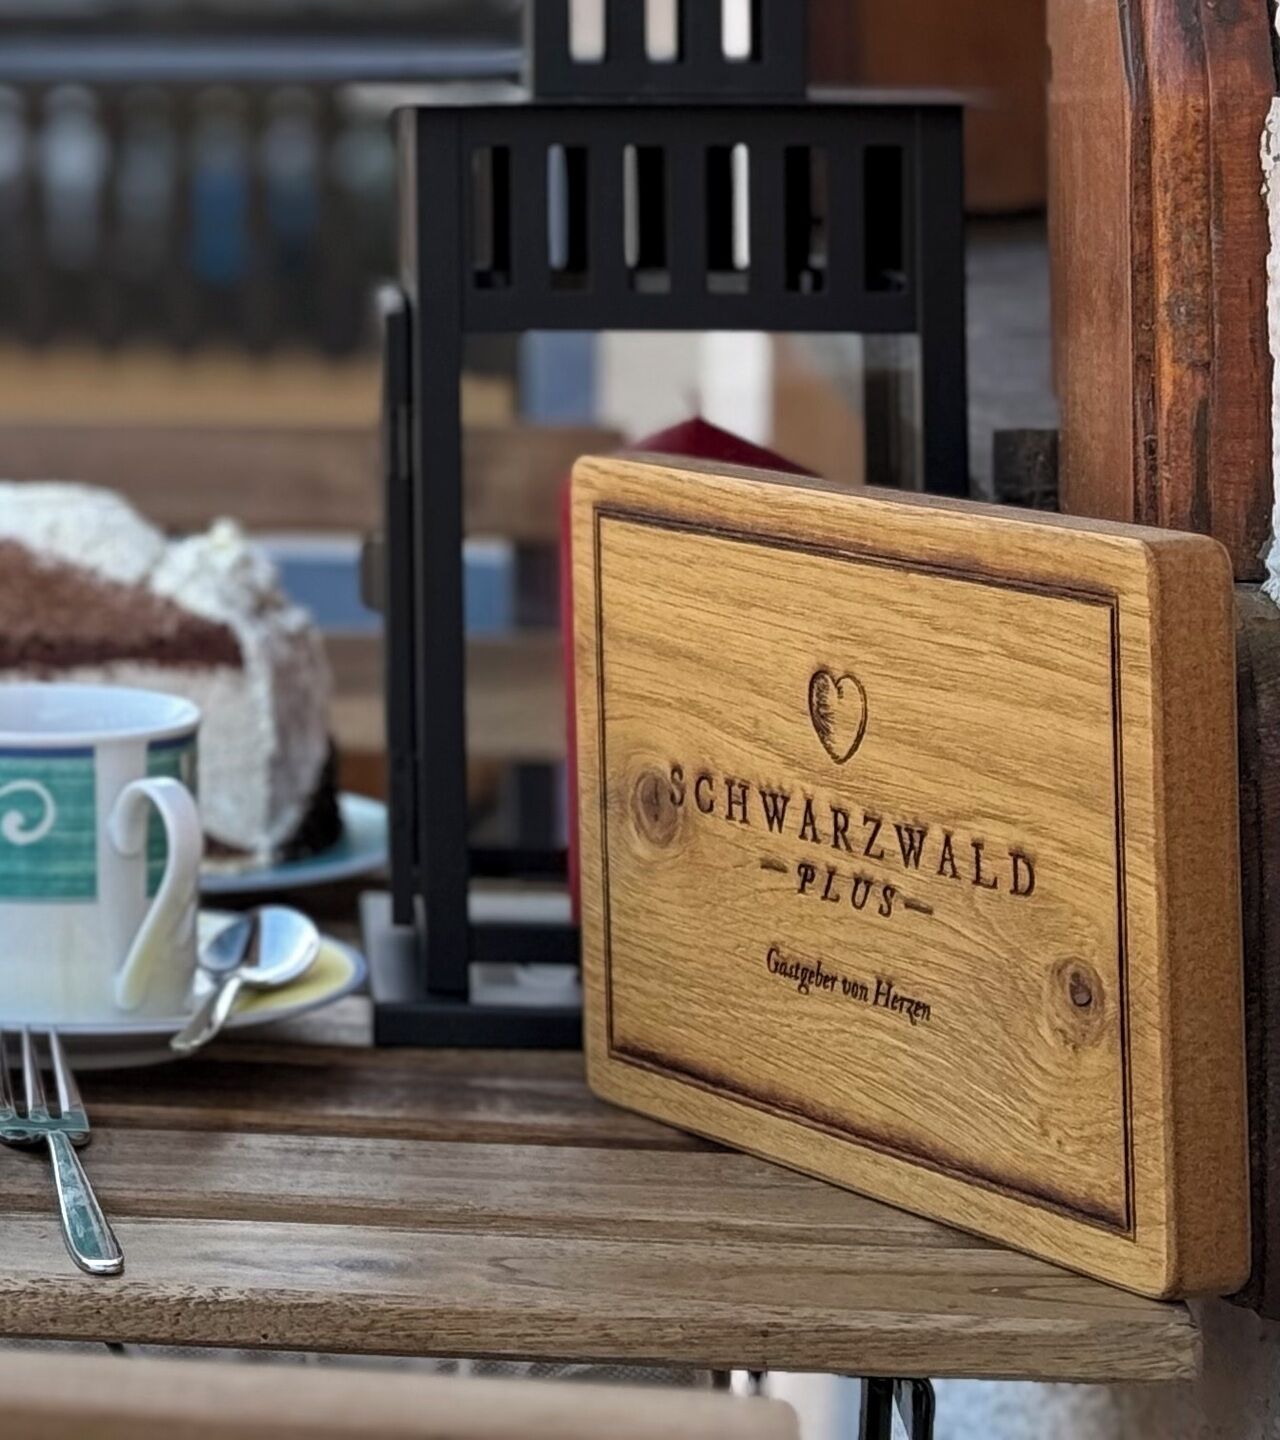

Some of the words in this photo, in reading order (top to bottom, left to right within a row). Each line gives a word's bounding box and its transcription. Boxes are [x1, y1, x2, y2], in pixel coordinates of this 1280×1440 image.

[669, 763, 1036, 898] SCHWARZWALD
[766, 947, 837, 995] Gastgeber
[842, 978, 868, 1002] von
[873, 978, 932, 1026] Herzen
